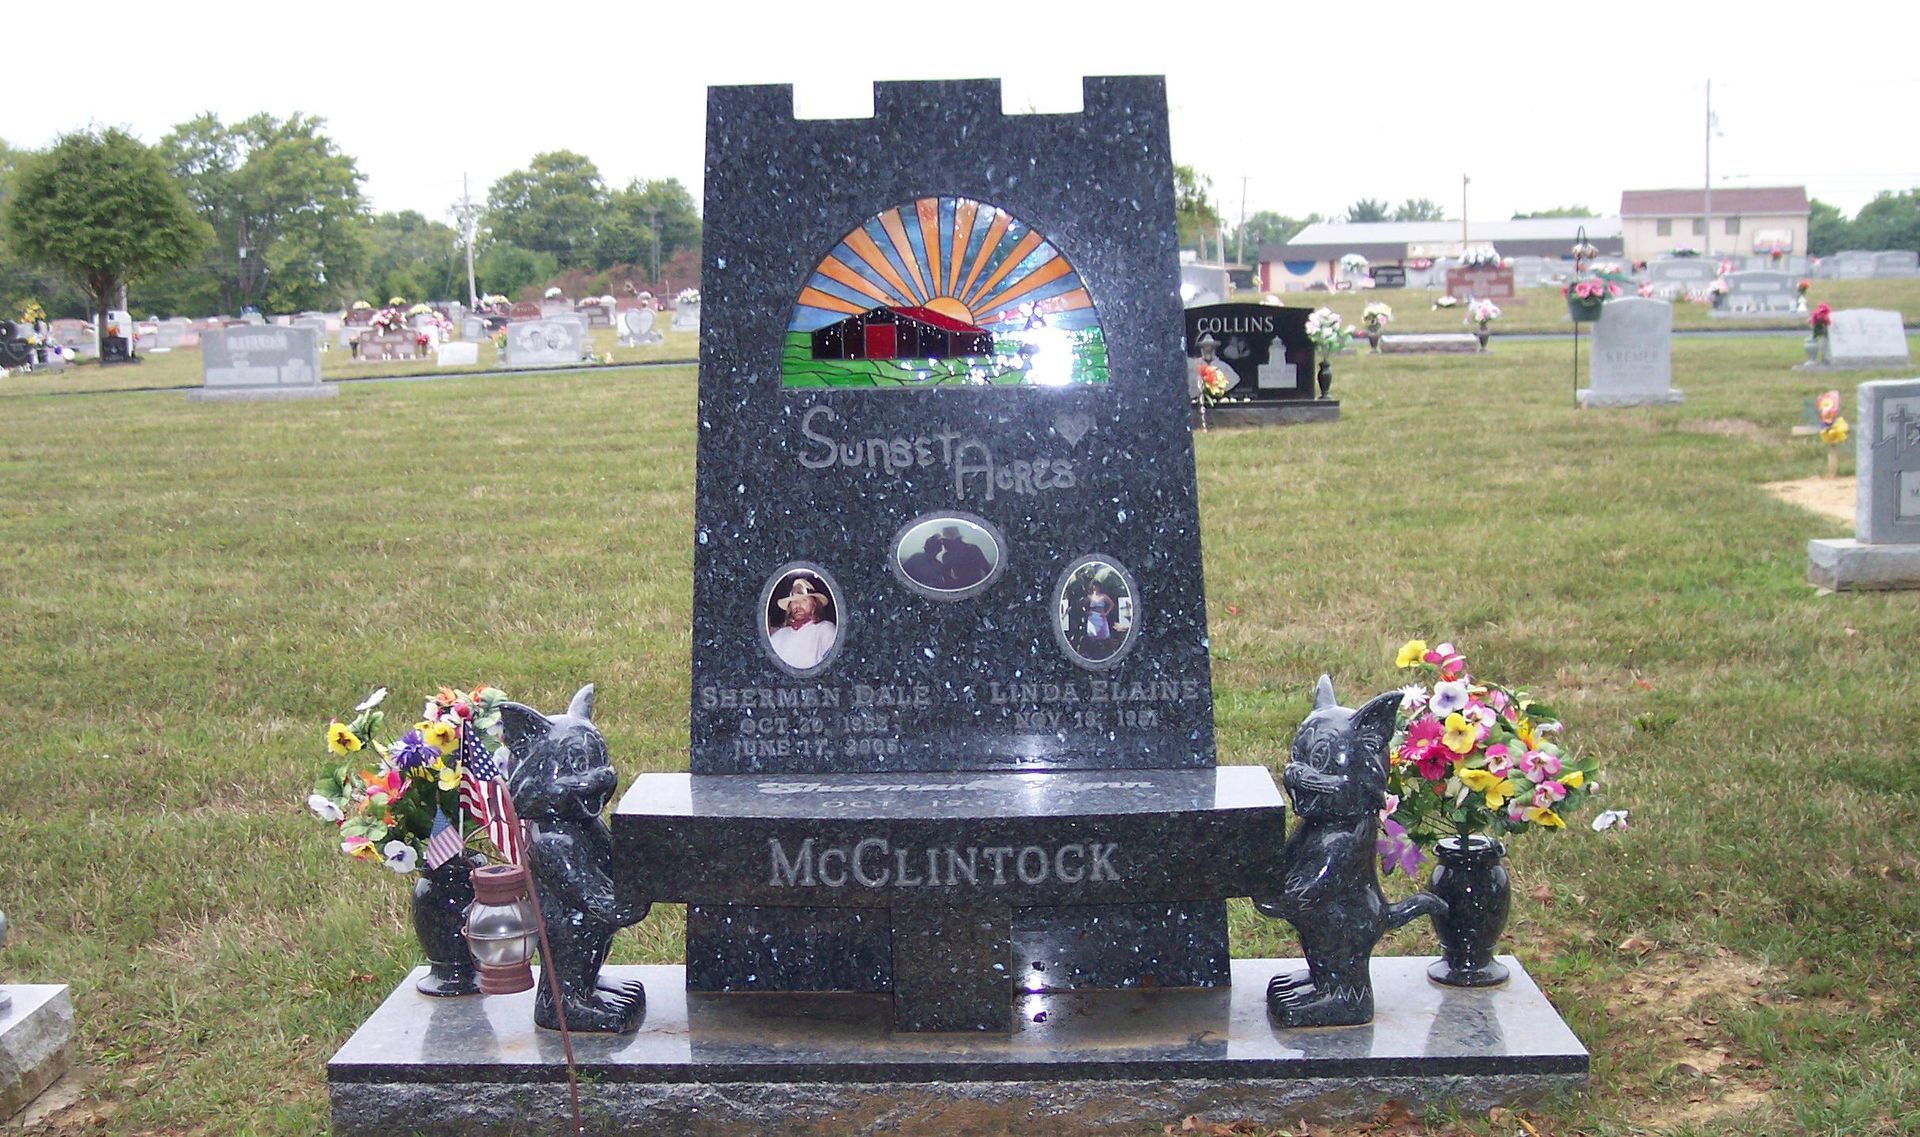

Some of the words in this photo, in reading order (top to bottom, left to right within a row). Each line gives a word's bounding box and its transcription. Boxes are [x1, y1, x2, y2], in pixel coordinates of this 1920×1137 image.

[1197, 316, 1274, 334] COLLINS
[851, 683, 932, 709] DALE
[989, 681, 1080, 704] LINDA
[1089, 680, 1200, 703] ELAINE
[740, 716, 789, 735] OCT
[1014, 710, 1063, 730] NOV
[733, 738, 792, 759] JUNE
